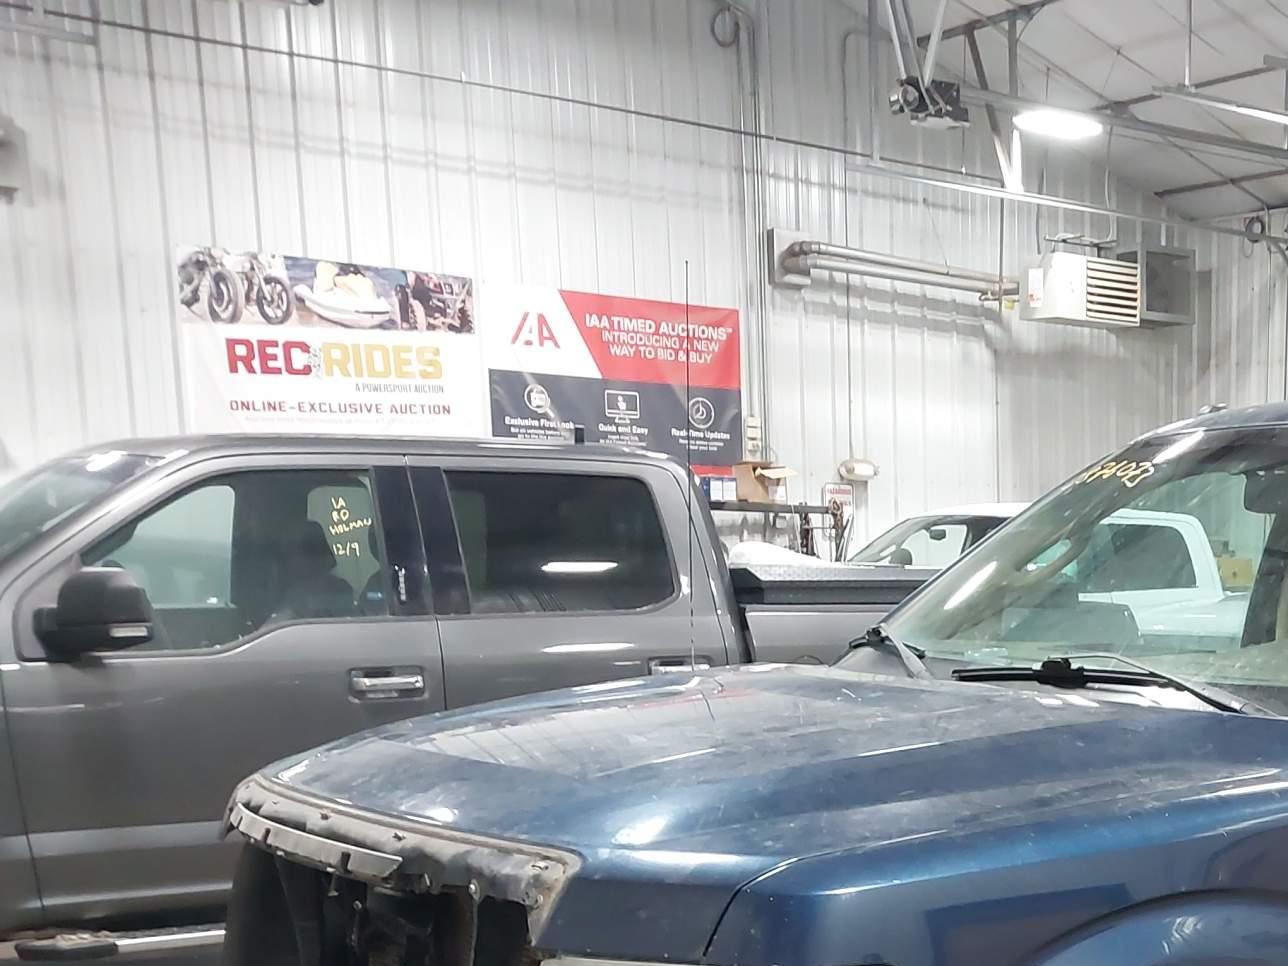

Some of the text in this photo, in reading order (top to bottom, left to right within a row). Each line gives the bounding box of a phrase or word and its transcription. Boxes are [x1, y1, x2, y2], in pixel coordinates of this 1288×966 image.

[585, 313, 609, 329] IAA
[611, 315, 656, 333] TIMED
[602, 330, 720, 353] INTRODUCING A NEW
[225, 338, 313, 376] REC
[320, 341, 443, 380] RIDES
[609, 345, 713, 364] WAY TO BID & BUY
[355, 382, 444, 394] A POWERSPORT AUCTION
[230, 399, 451, 415] ONLINE-EXCLUSIVE AUCTION
[504, 415, 539, 427] Exclusive
[598, 423, 649, 436] Quick and Easy
[705, 429, 730, 440] Updates
[333, 541, 360, 557] 12/9
